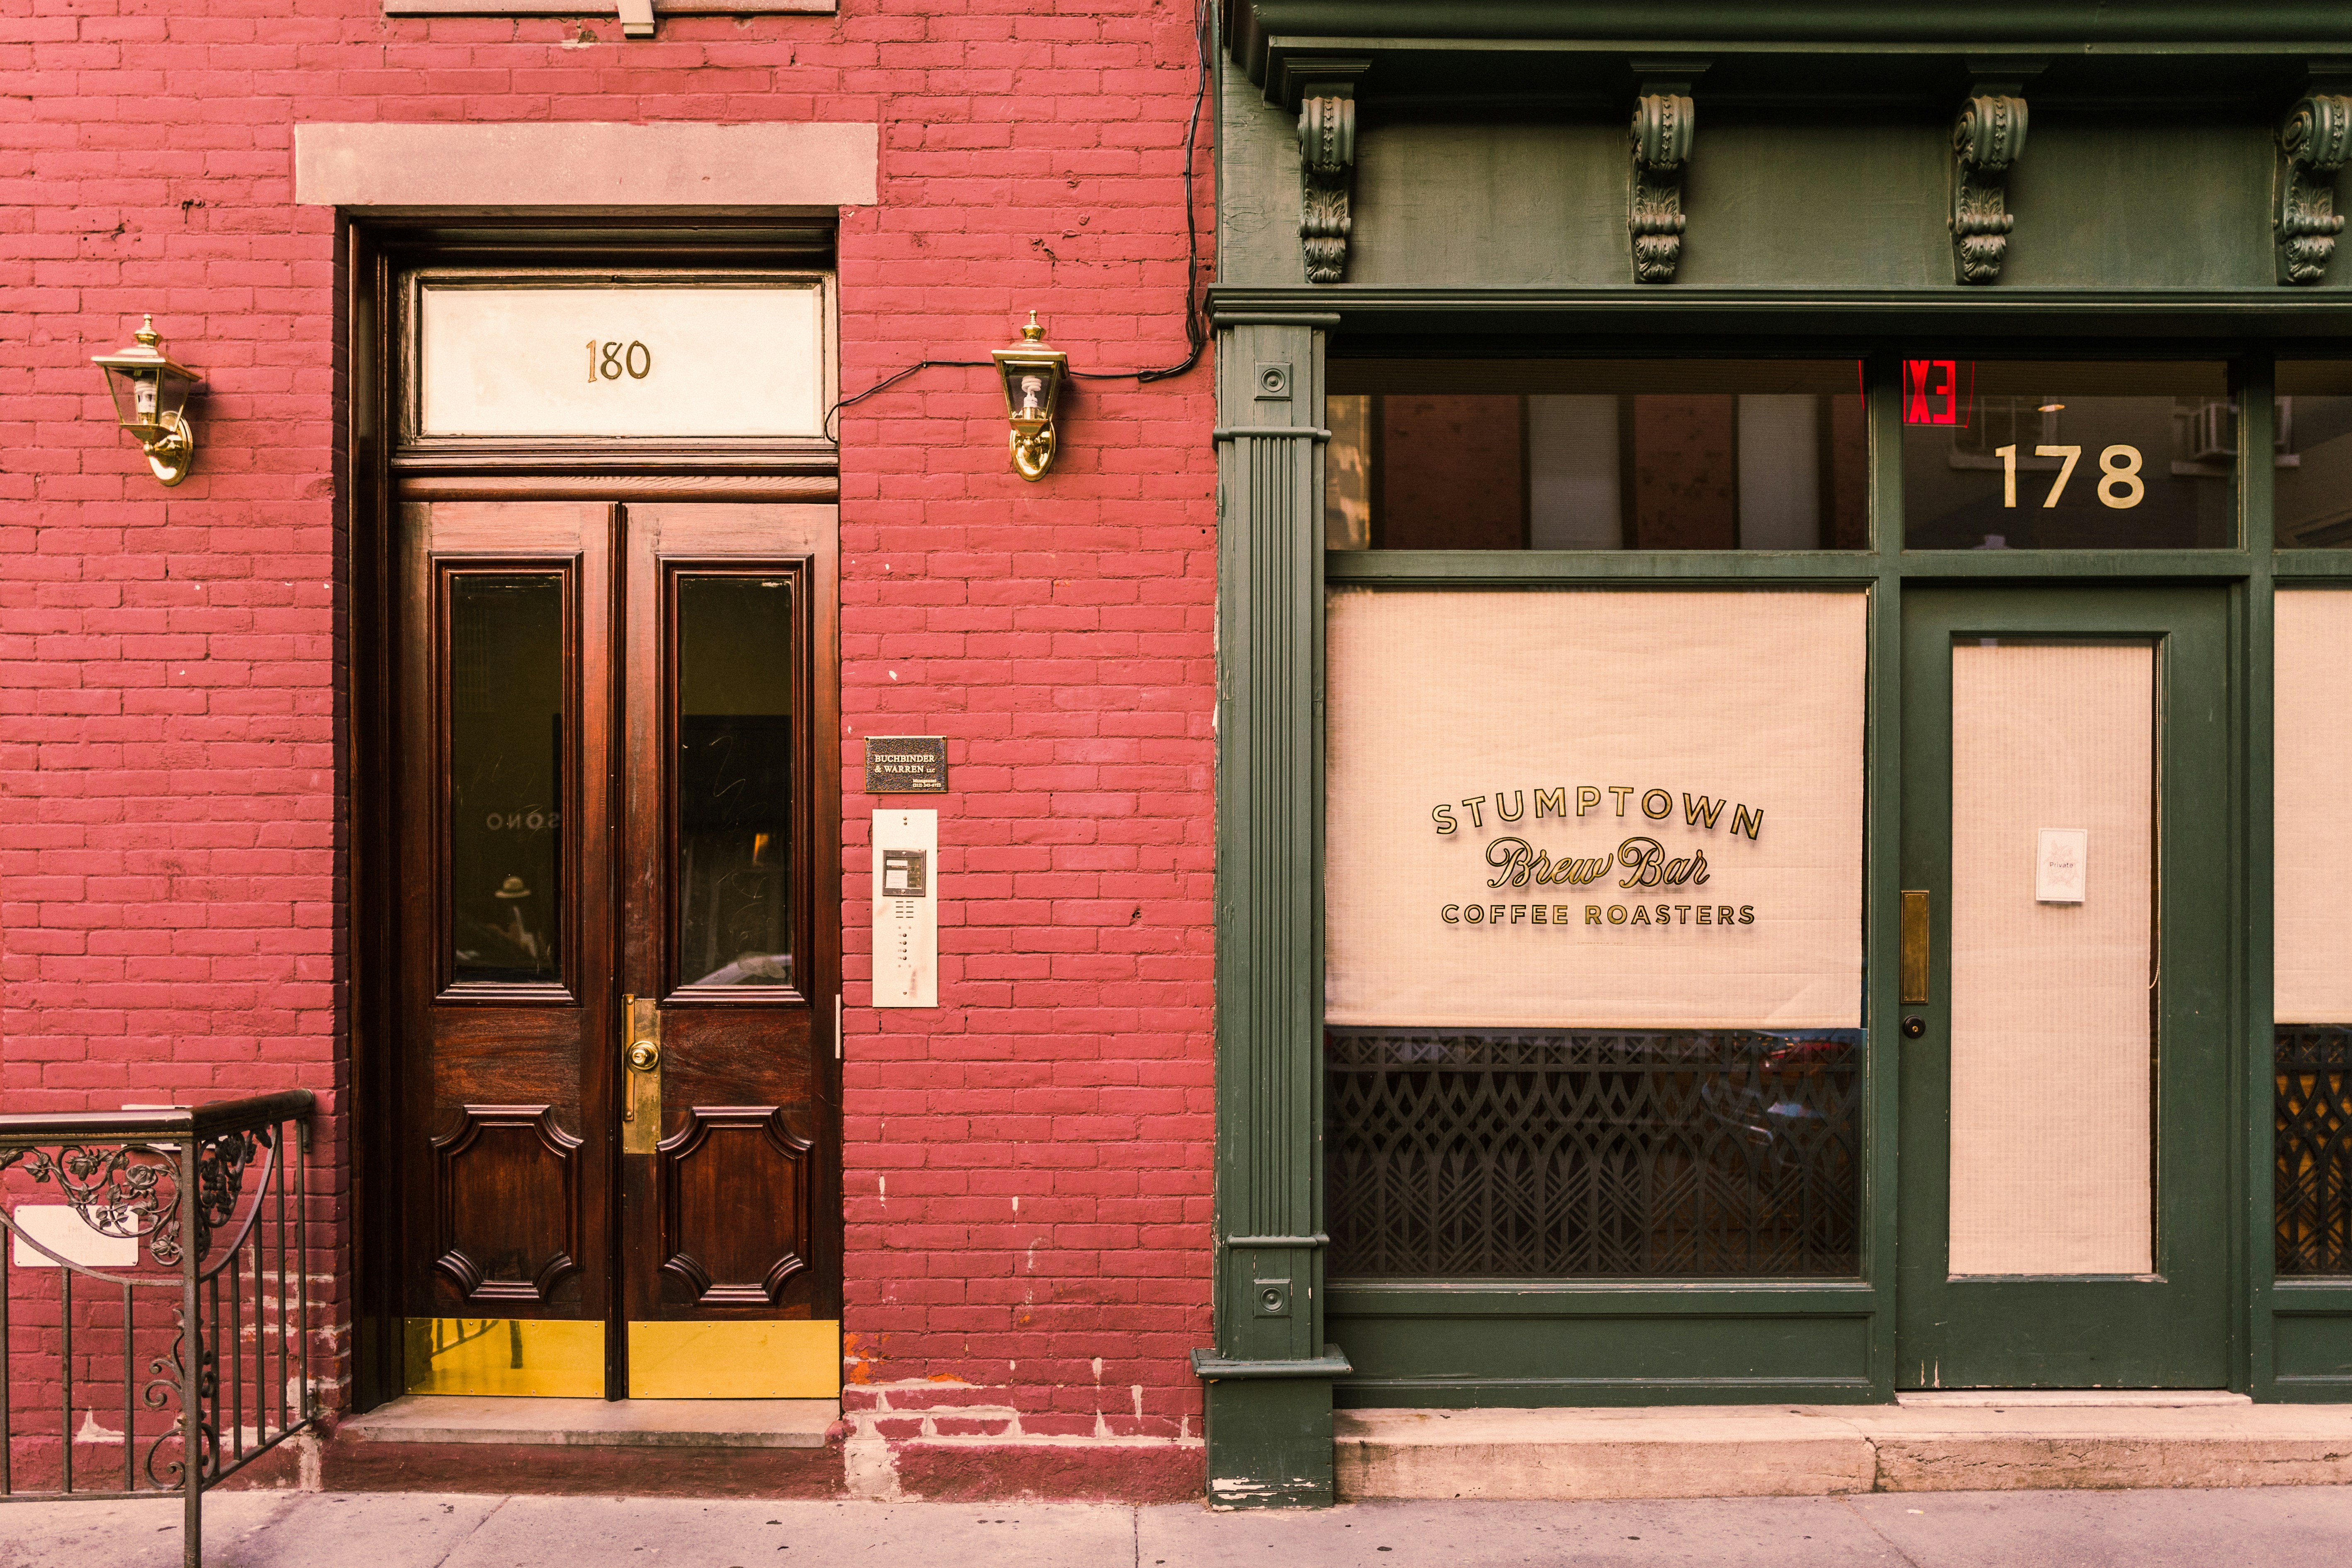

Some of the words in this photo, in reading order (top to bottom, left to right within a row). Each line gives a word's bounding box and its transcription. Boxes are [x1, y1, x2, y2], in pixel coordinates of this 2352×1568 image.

[586, 339, 650, 383] 180
[1994, 443, 2145, 509] 178
[1432, 786, 1764, 841] STUMPTOWN
[1486, 836, 1613, 889] Brew
[1617, 836, 1710, 889] Bar
[1441, 904, 1568, 925] COFFEE
[1585, 904, 1755, 925] ROASTERS
